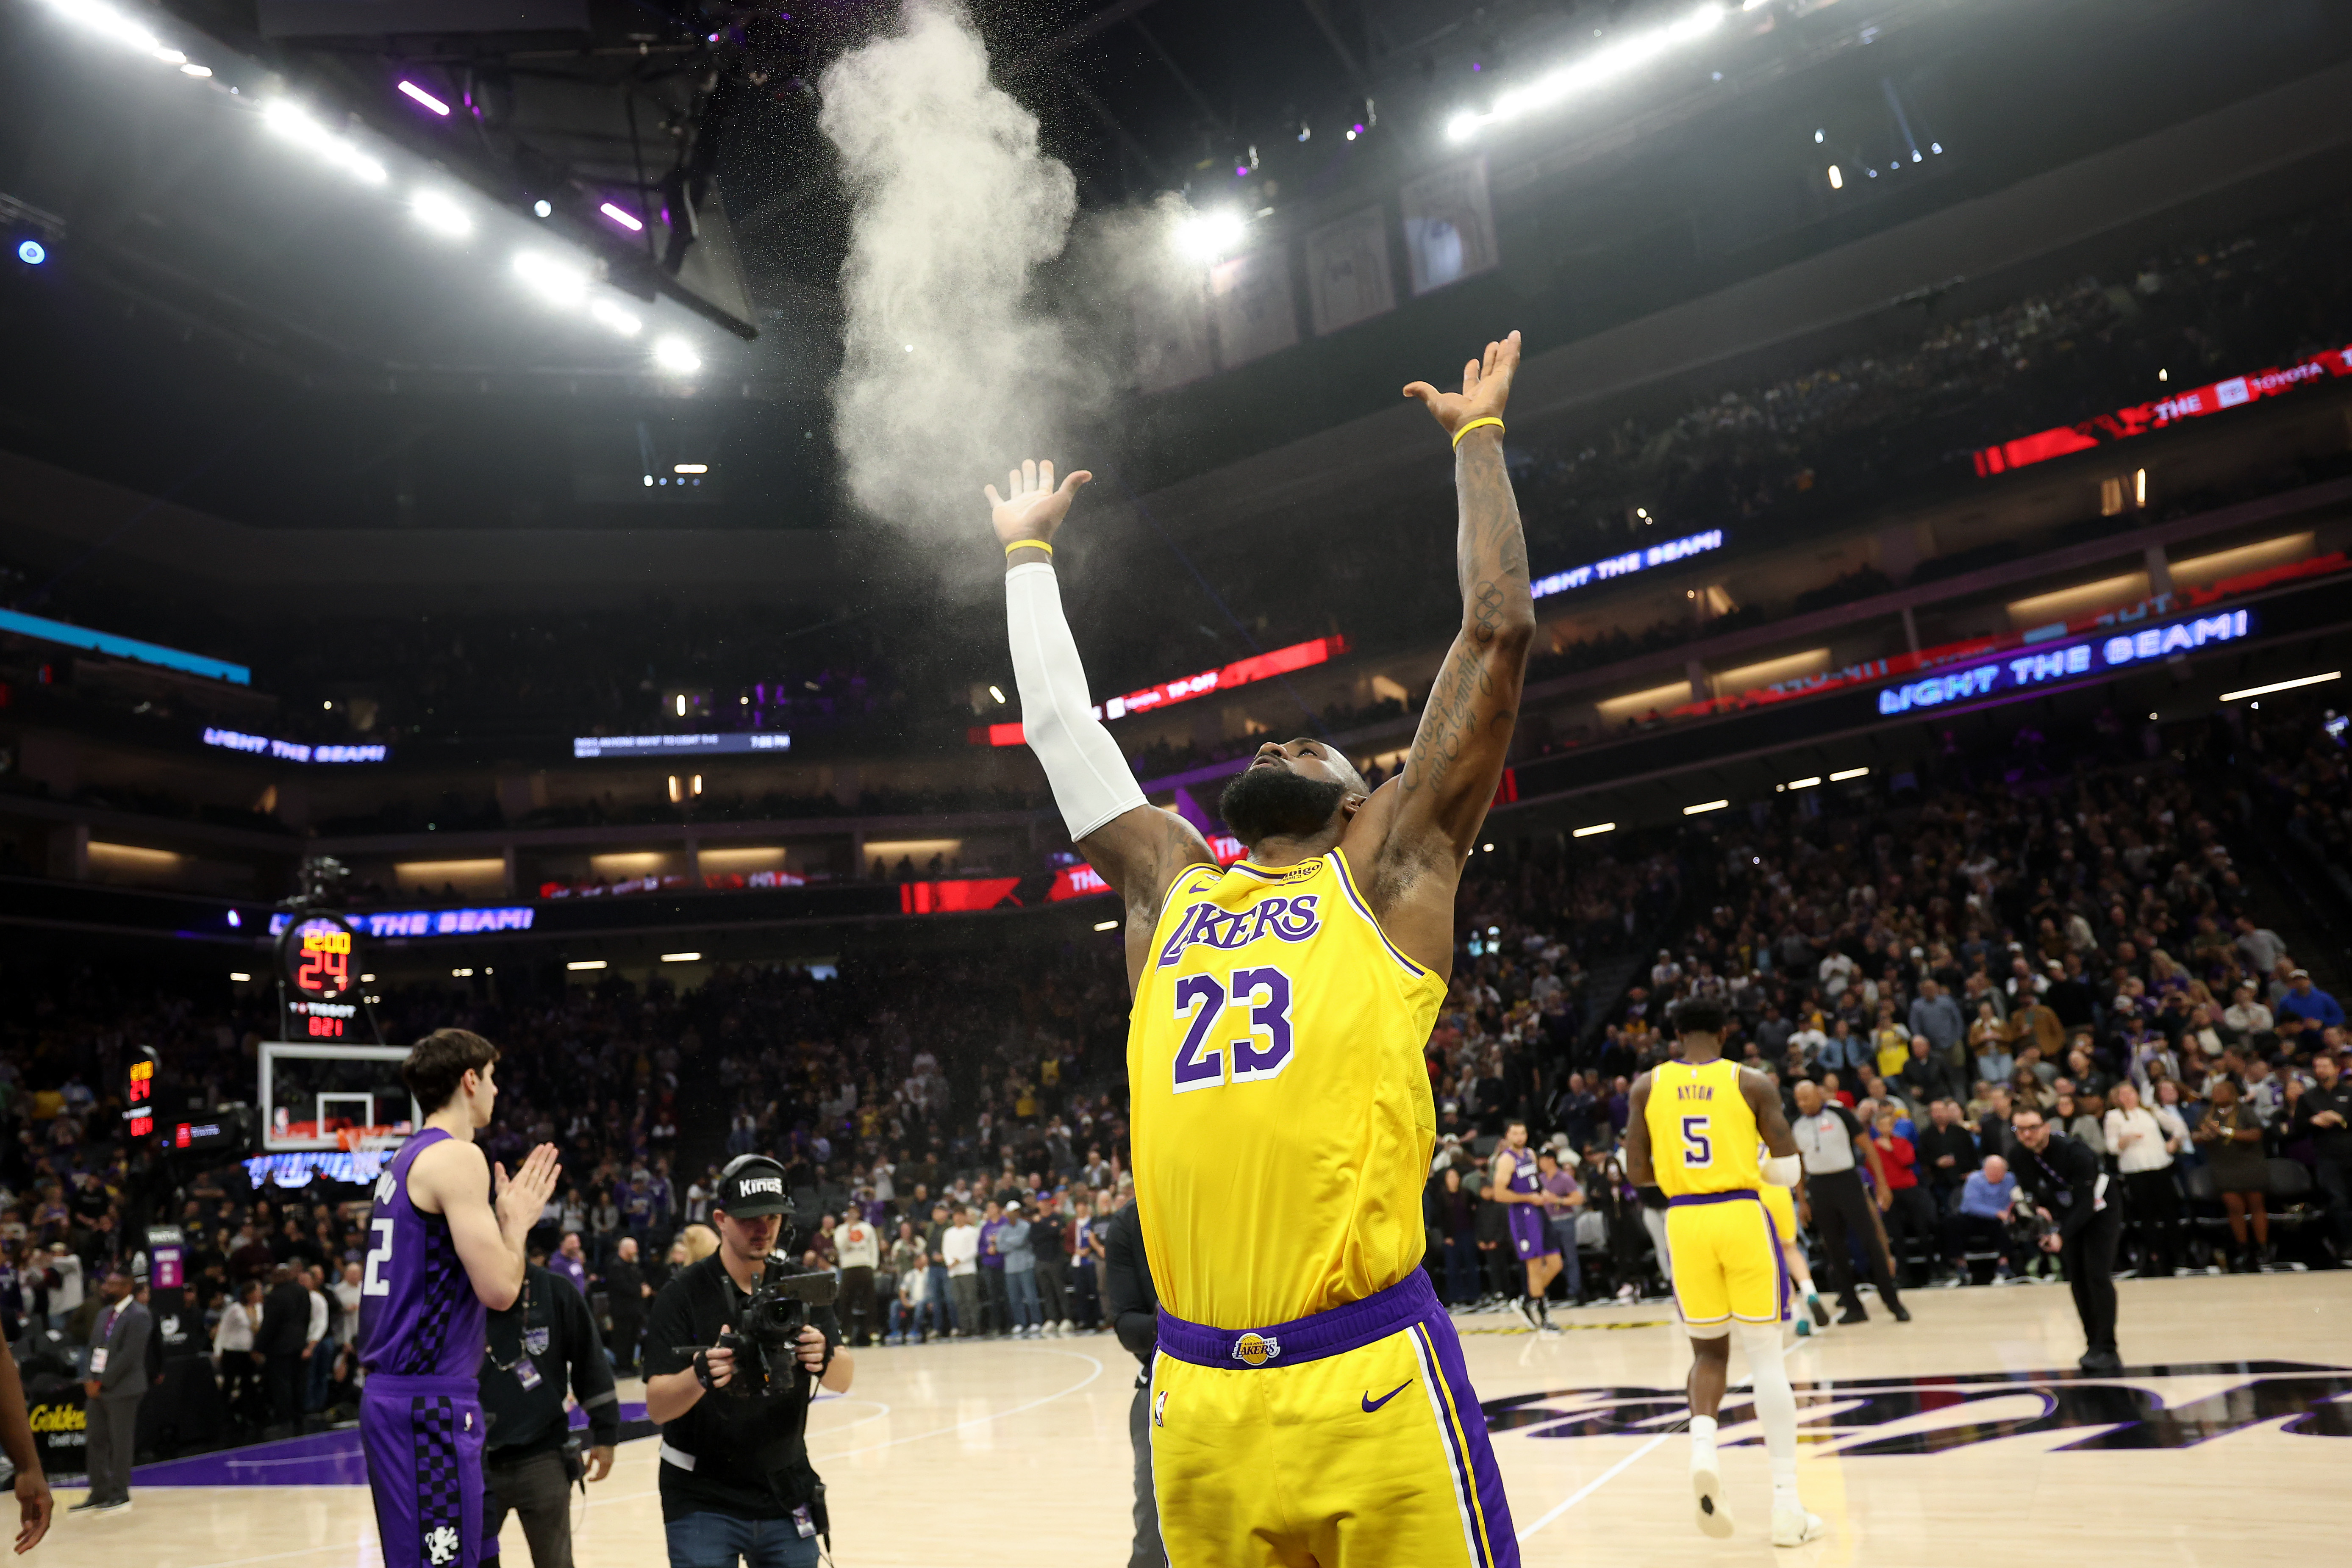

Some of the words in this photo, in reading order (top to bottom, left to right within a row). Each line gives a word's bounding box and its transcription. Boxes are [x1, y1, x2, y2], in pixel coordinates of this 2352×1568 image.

[2154, 394, 2203, 420] THE
[2251, 362, 2324, 391] TOYOTA
[1595, 552, 1641, 580] THE
[1647, 528, 1722, 566] BEAM!
[1878, 665, 2000, 715] LIGHT
[2008, 644, 2092, 685] THE
[2103, 609, 2249, 666] BEAM!
[1166, 672, 1219, 699] TIP-OFF
[1284, 865, 1320, 877] bigo
[371, 914, 428, 937] THE
[436, 908, 535, 934] BEAM!
[299, 948, 348, 992] 24
[1172, 964, 1294, 1095] 23
[1677, 1085, 1715, 1102] AYTON
[1680, 1114, 1714, 1169] 5
[1233, 1343, 1279, 1358] LAKERS
